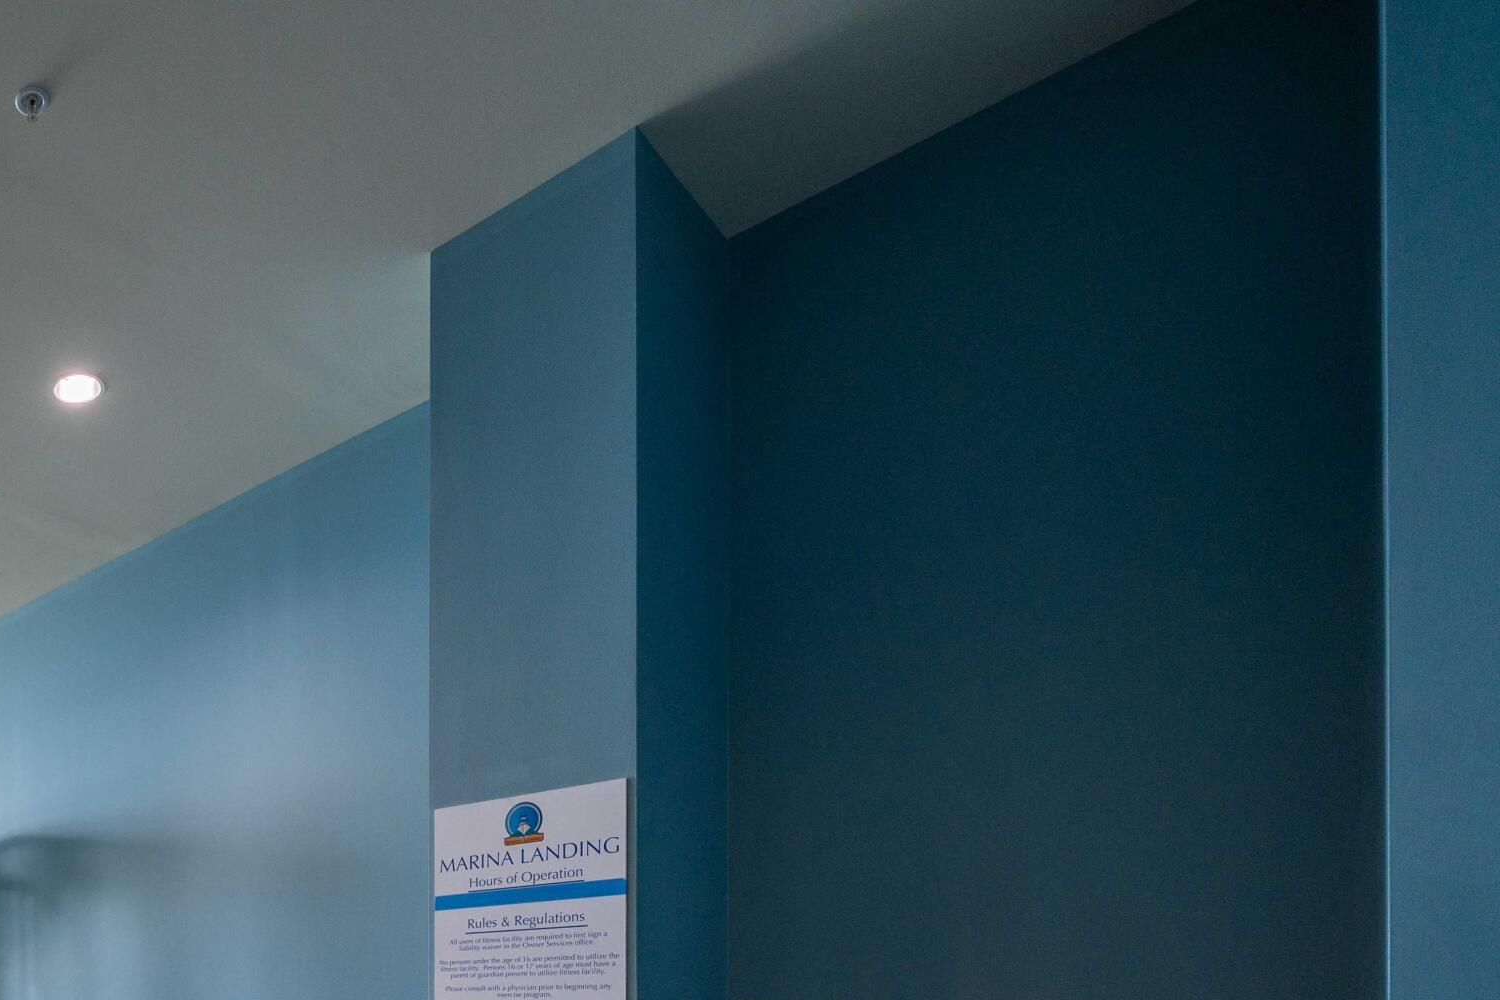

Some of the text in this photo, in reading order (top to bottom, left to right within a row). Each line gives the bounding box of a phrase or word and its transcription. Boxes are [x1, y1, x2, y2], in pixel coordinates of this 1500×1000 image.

[439, 837, 620, 874] MARINA LANDING
[469, 867, 584, 888] Hours of Operation
[467, 912, 585, 929] Rules & Regulations
[536, 933, 564, 941] required
[544, 954, 575, 962] permitted
[478, 971, 504, 979] guardian
[582, 968, 606, 976] facility.
[508, 984, 537, 992] physician
[538, 985, 554, 993] prior
